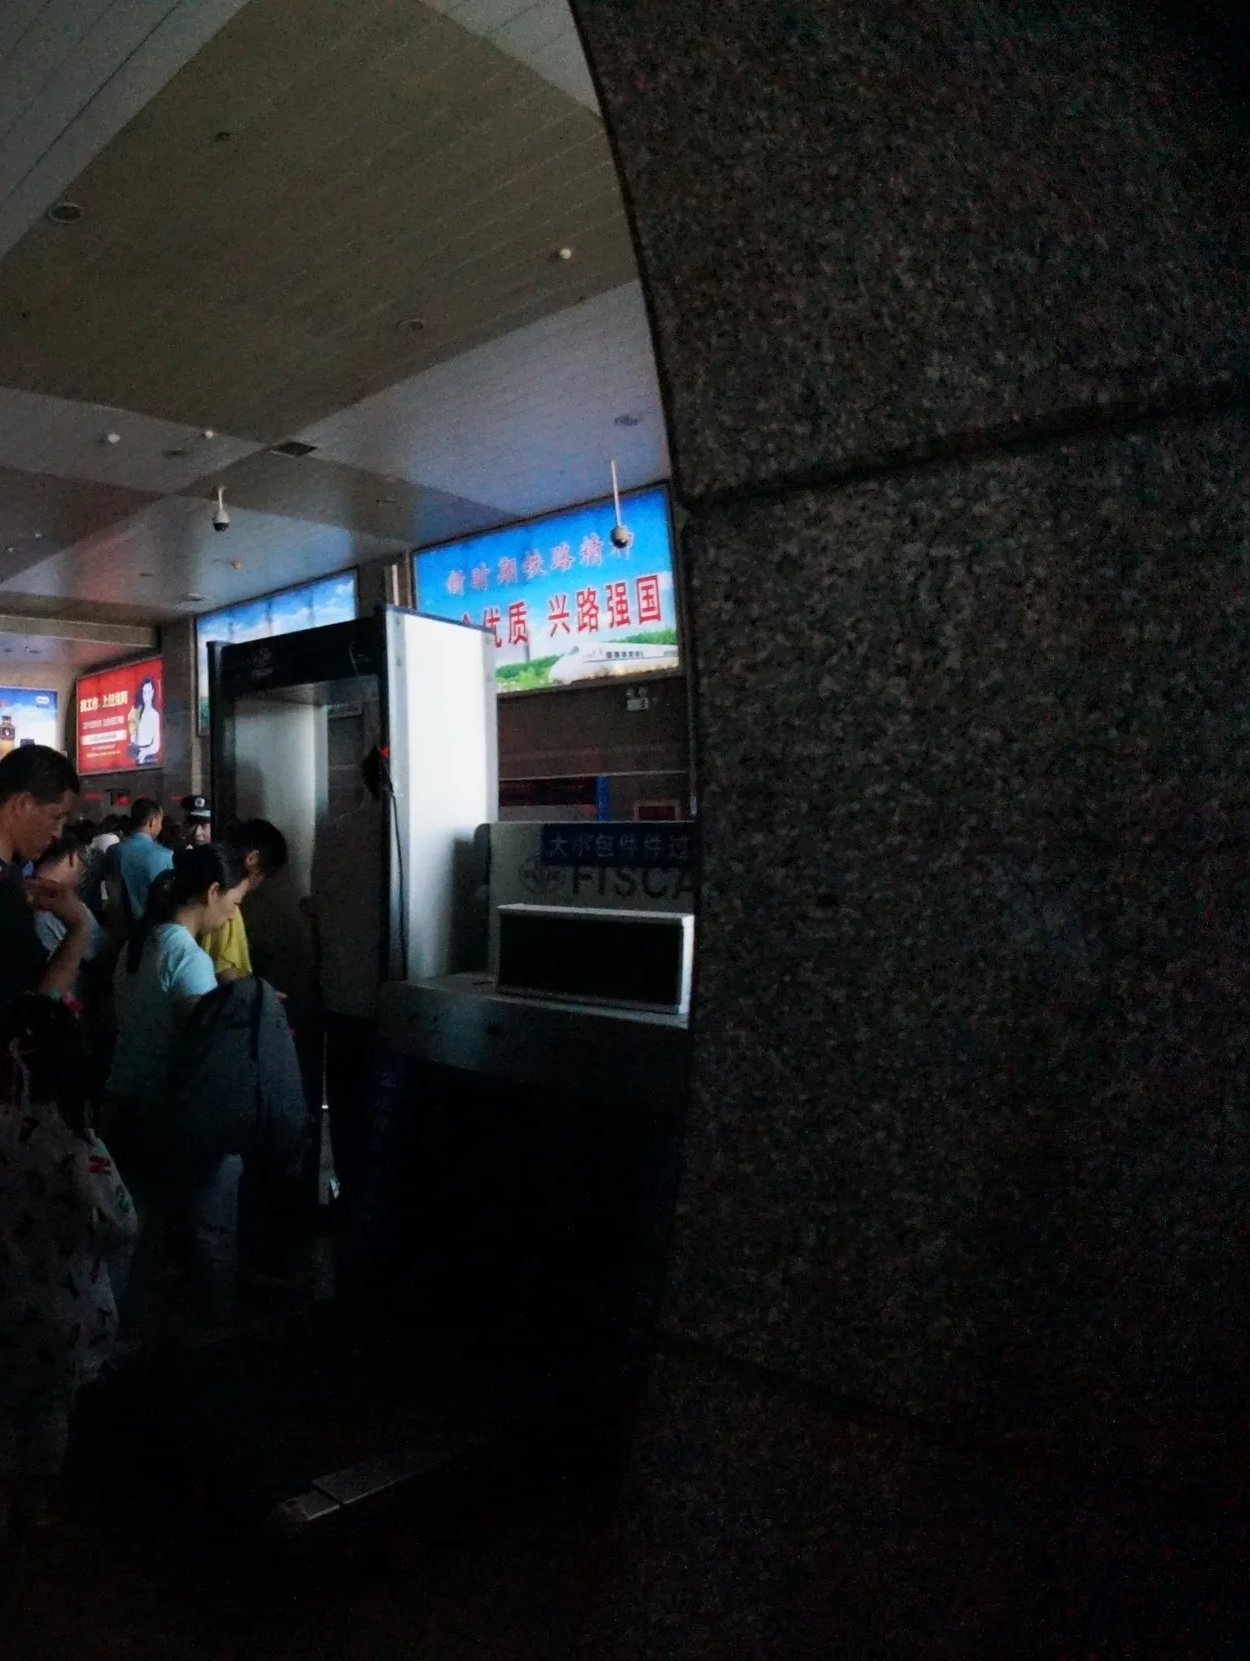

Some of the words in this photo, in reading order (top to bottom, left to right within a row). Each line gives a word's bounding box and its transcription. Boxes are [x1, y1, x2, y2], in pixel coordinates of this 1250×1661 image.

[461, 601, 529, 648] 优质
[548, 574, 662, 638] 兴路强国
